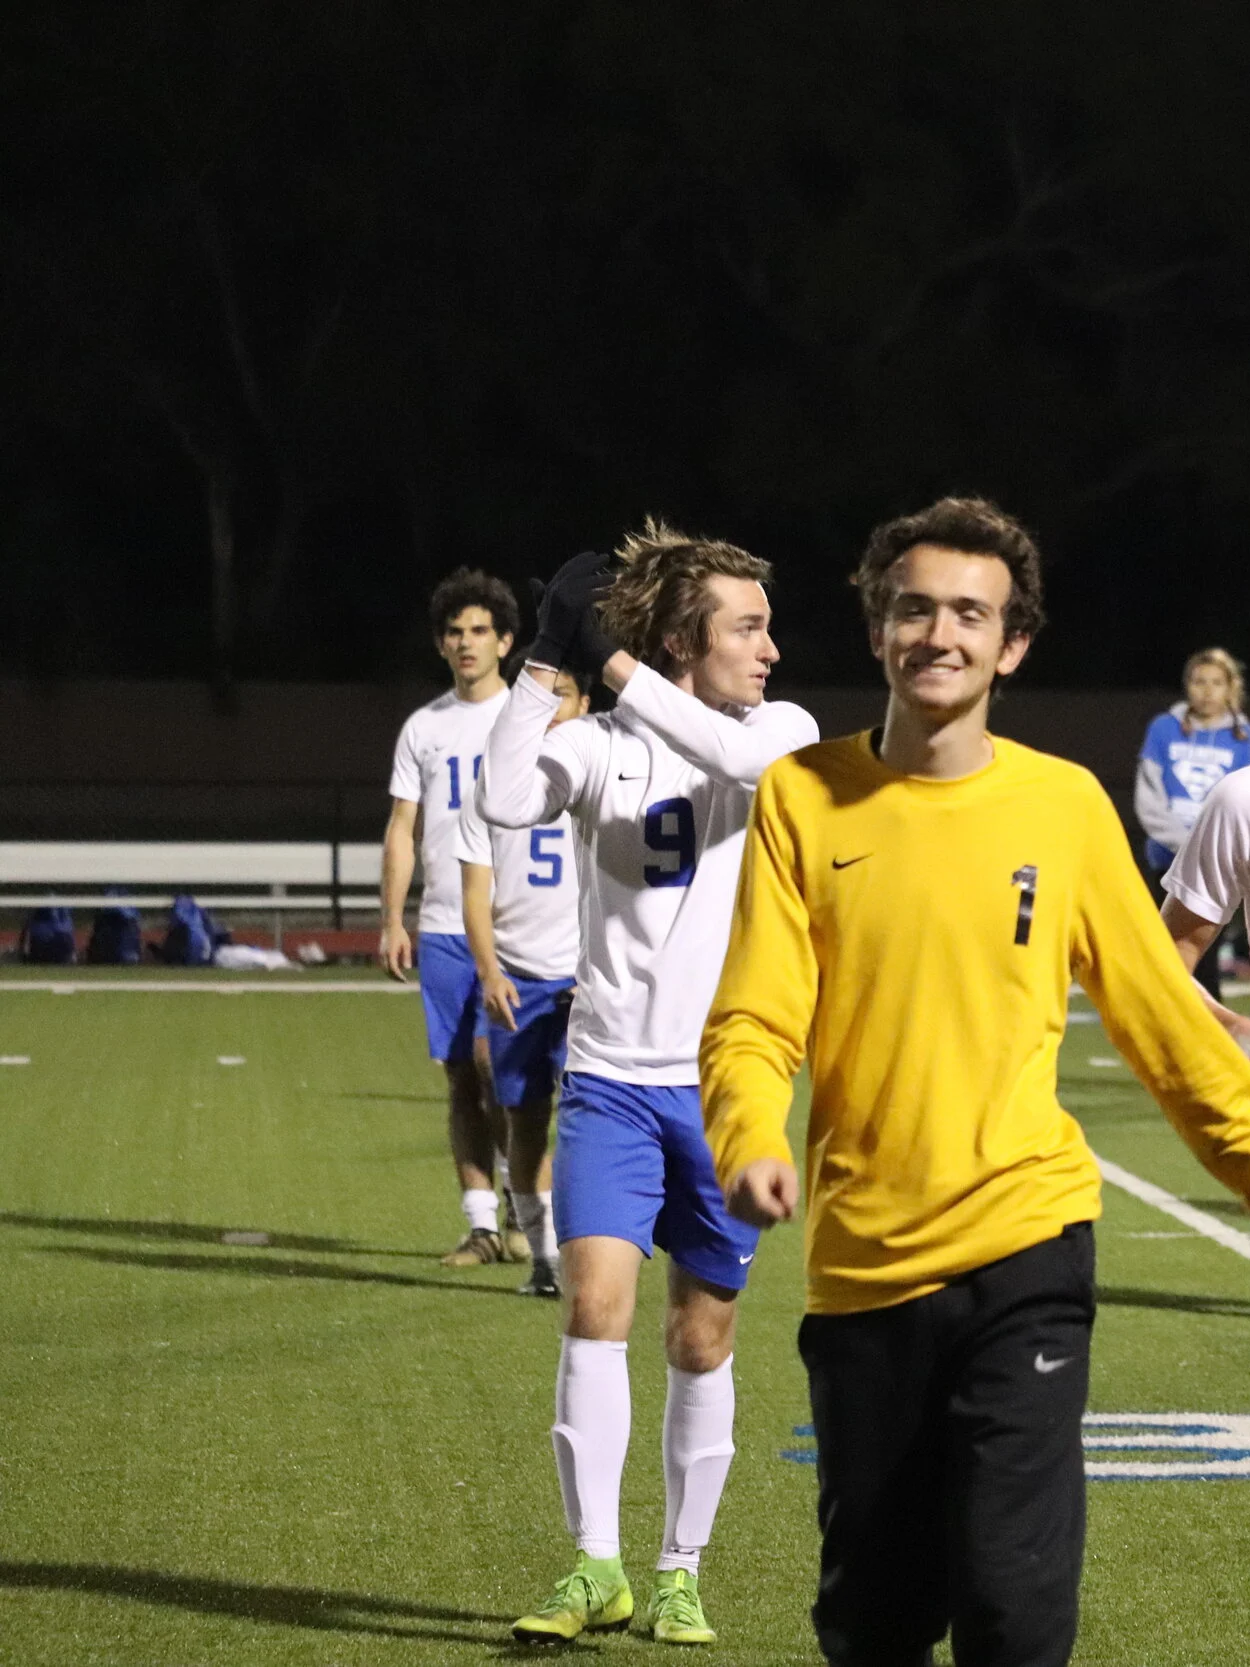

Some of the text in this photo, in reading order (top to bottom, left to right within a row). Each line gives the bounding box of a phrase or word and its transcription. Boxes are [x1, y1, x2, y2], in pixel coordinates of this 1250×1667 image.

[446, 755, 483, 810] 1
[527, 829, 565, 887] 5
[644, 797, 696, 887] 9
[1011, 864, 1037, 946] 1
